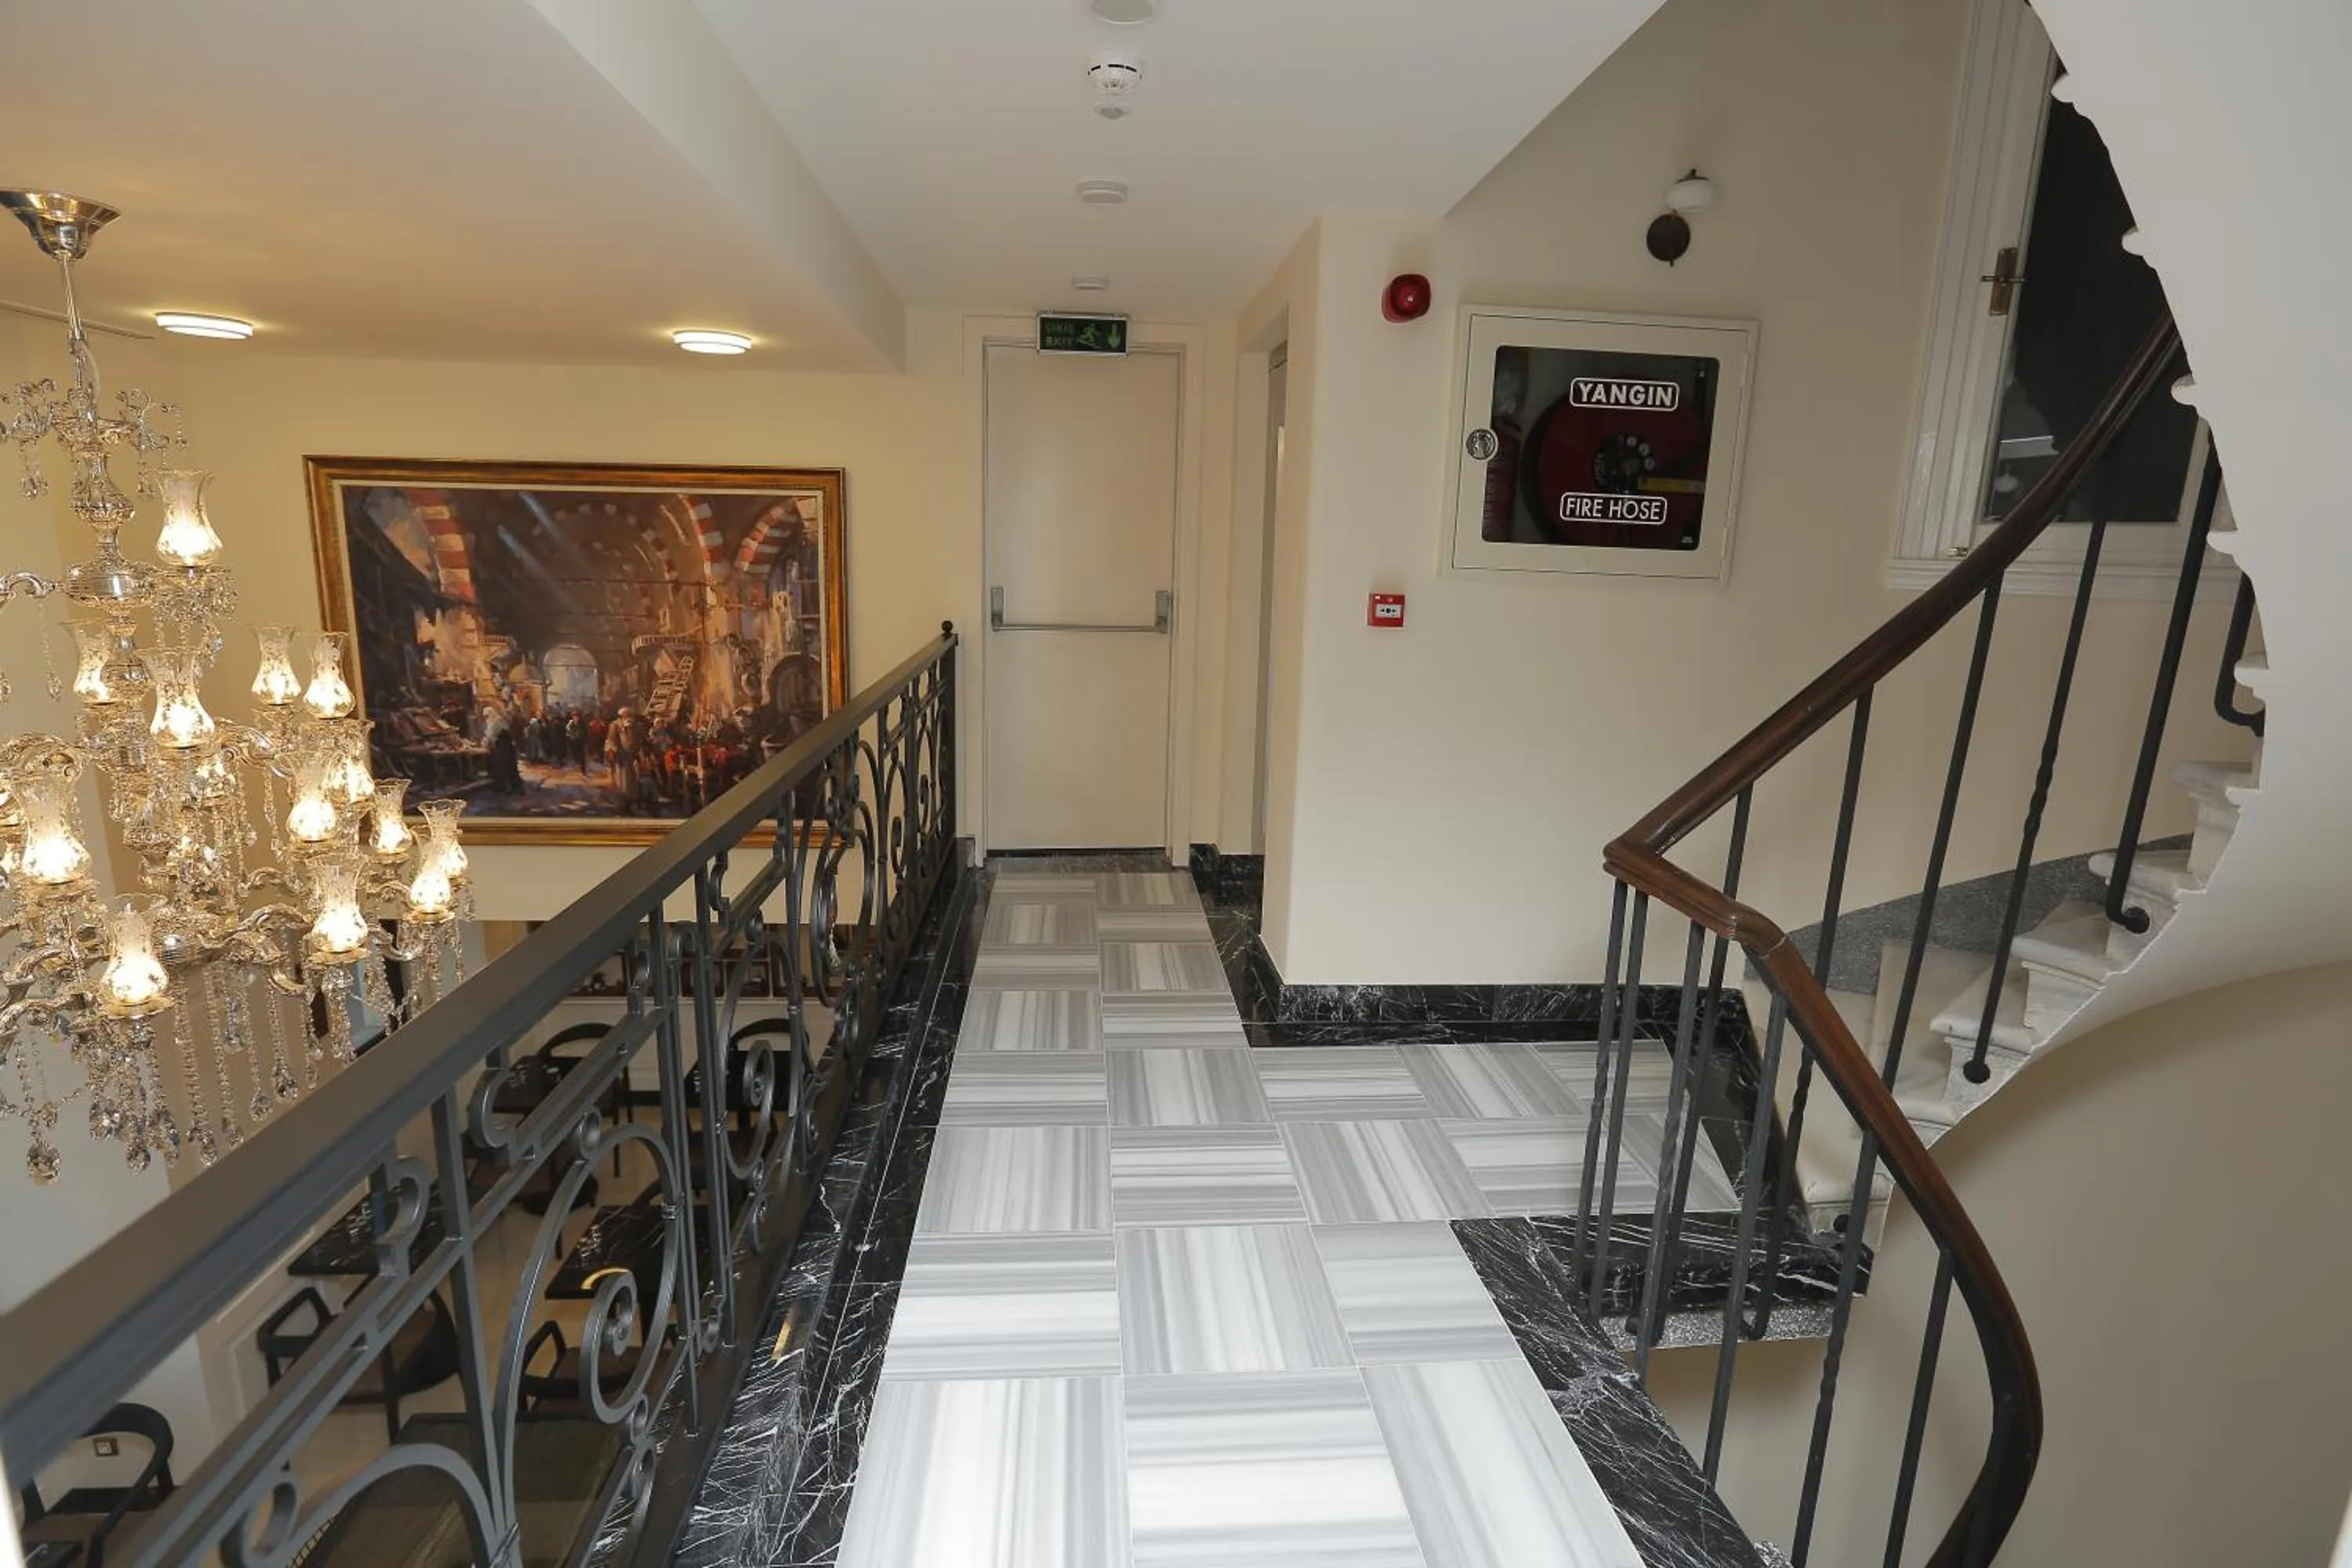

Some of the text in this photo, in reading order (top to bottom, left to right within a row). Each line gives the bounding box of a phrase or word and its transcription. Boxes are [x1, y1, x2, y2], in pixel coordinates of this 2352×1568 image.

[1045, 336, 1073, 347] EXIT
[1577, 383, 1672, 406] YANGIN
[1566, 498, 1661, 520] FIRE HOSE
